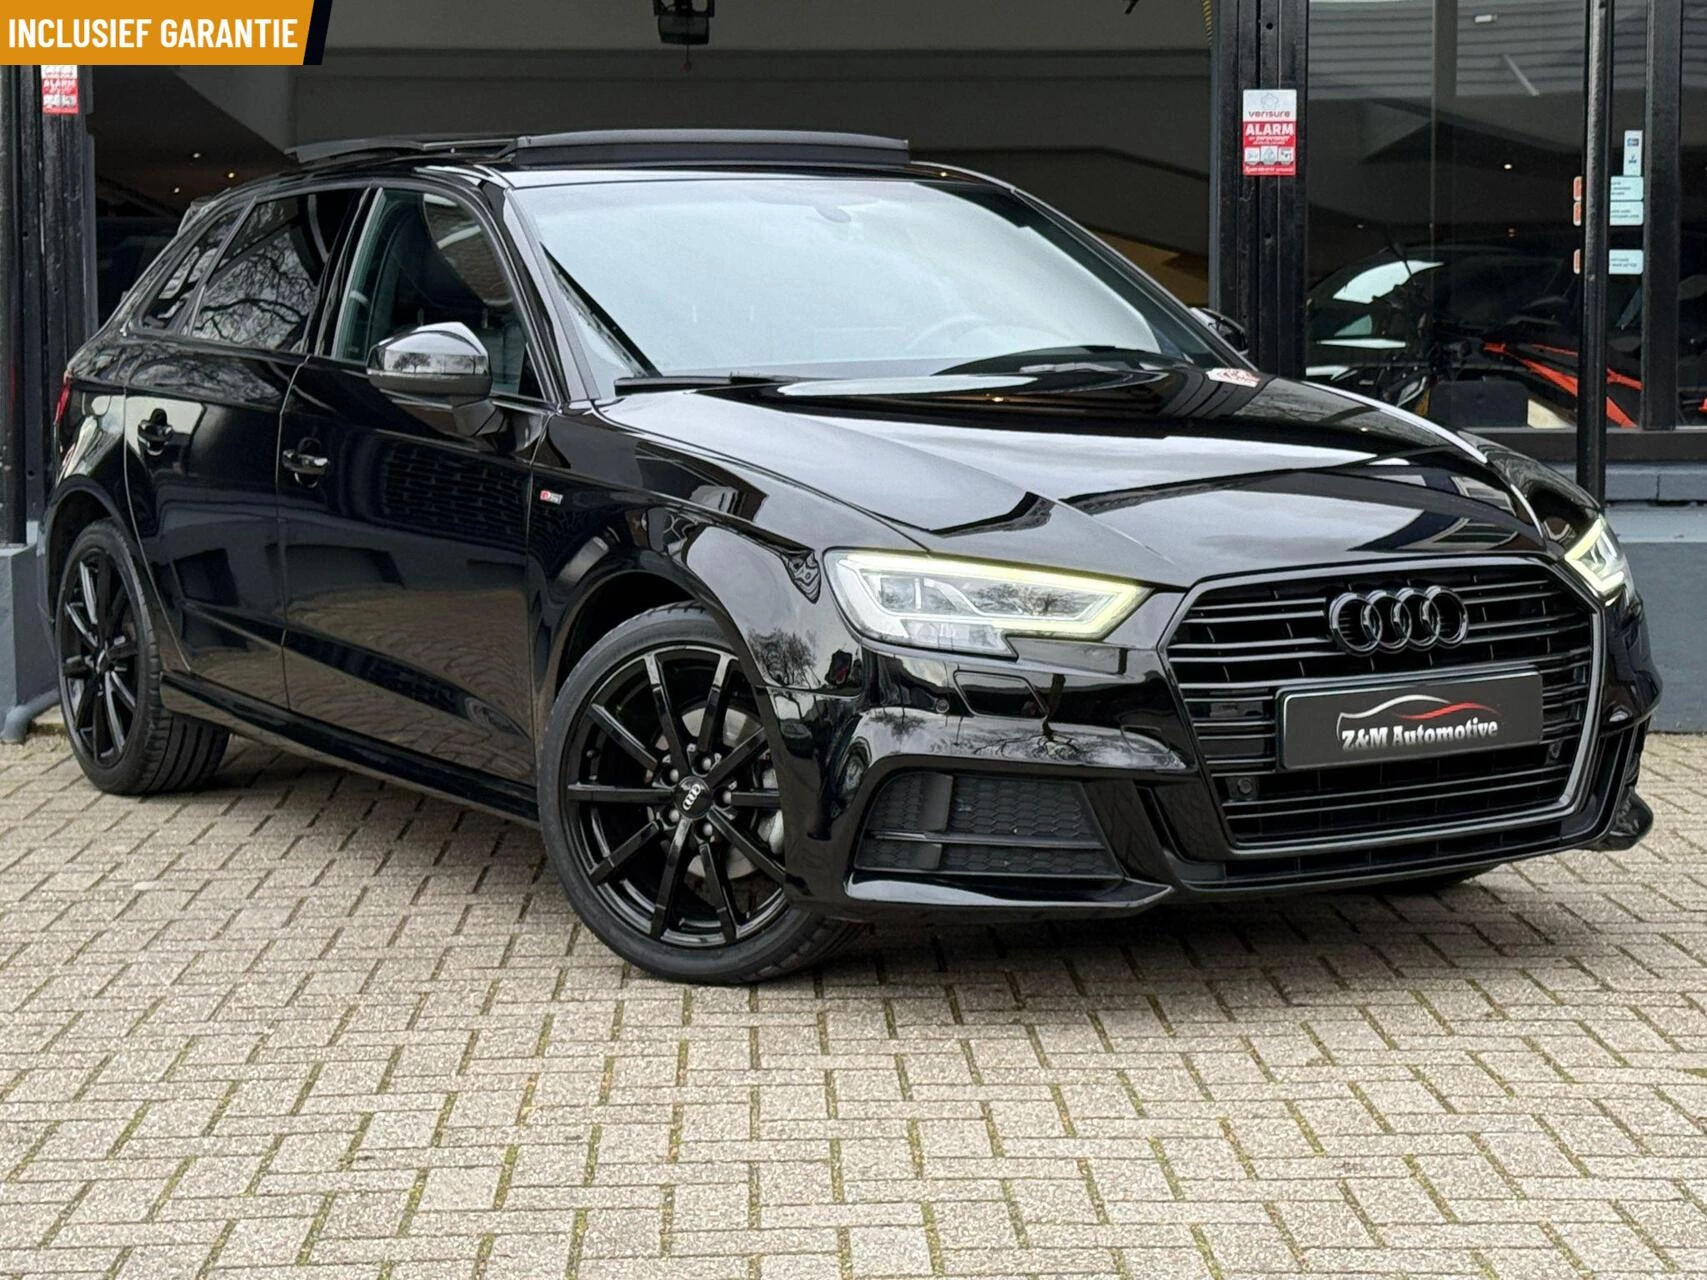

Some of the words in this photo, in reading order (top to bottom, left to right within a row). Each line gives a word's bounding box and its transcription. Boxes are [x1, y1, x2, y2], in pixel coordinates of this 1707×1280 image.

[1248, 110, 1291, 118] verisure
[1245, 123, 1294, 136] ALARM
[1341, 725, 1388, 751] Z&M
[1391, 717, 1499, 748] Automotive
